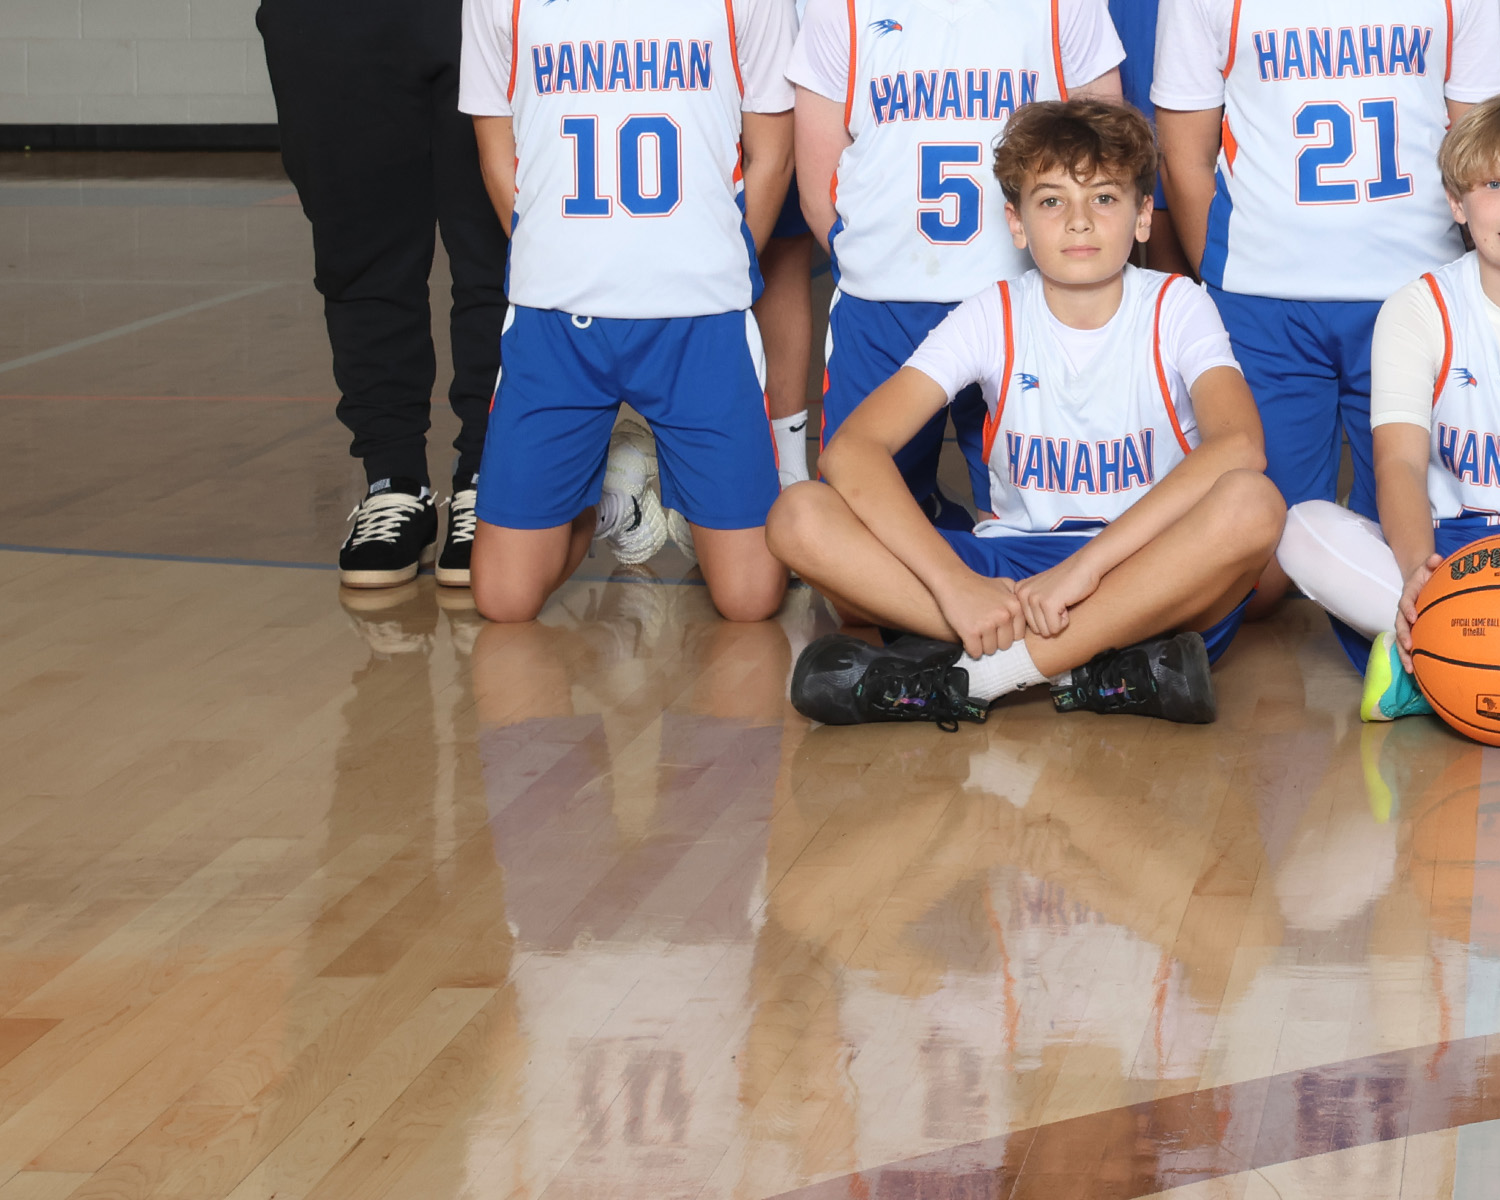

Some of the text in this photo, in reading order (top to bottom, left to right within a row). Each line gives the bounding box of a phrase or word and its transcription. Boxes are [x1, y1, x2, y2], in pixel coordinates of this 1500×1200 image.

[531, 38, 713, 96] HANAHAN
[1252, 24, 1433, 82] HANAHAN
[869, 68, 1039, 127] HANAHAN
[560, 113, 683, 219] 10
[1292, 96, 1414, 206] 21
[917, 142, 983, 245] 5
